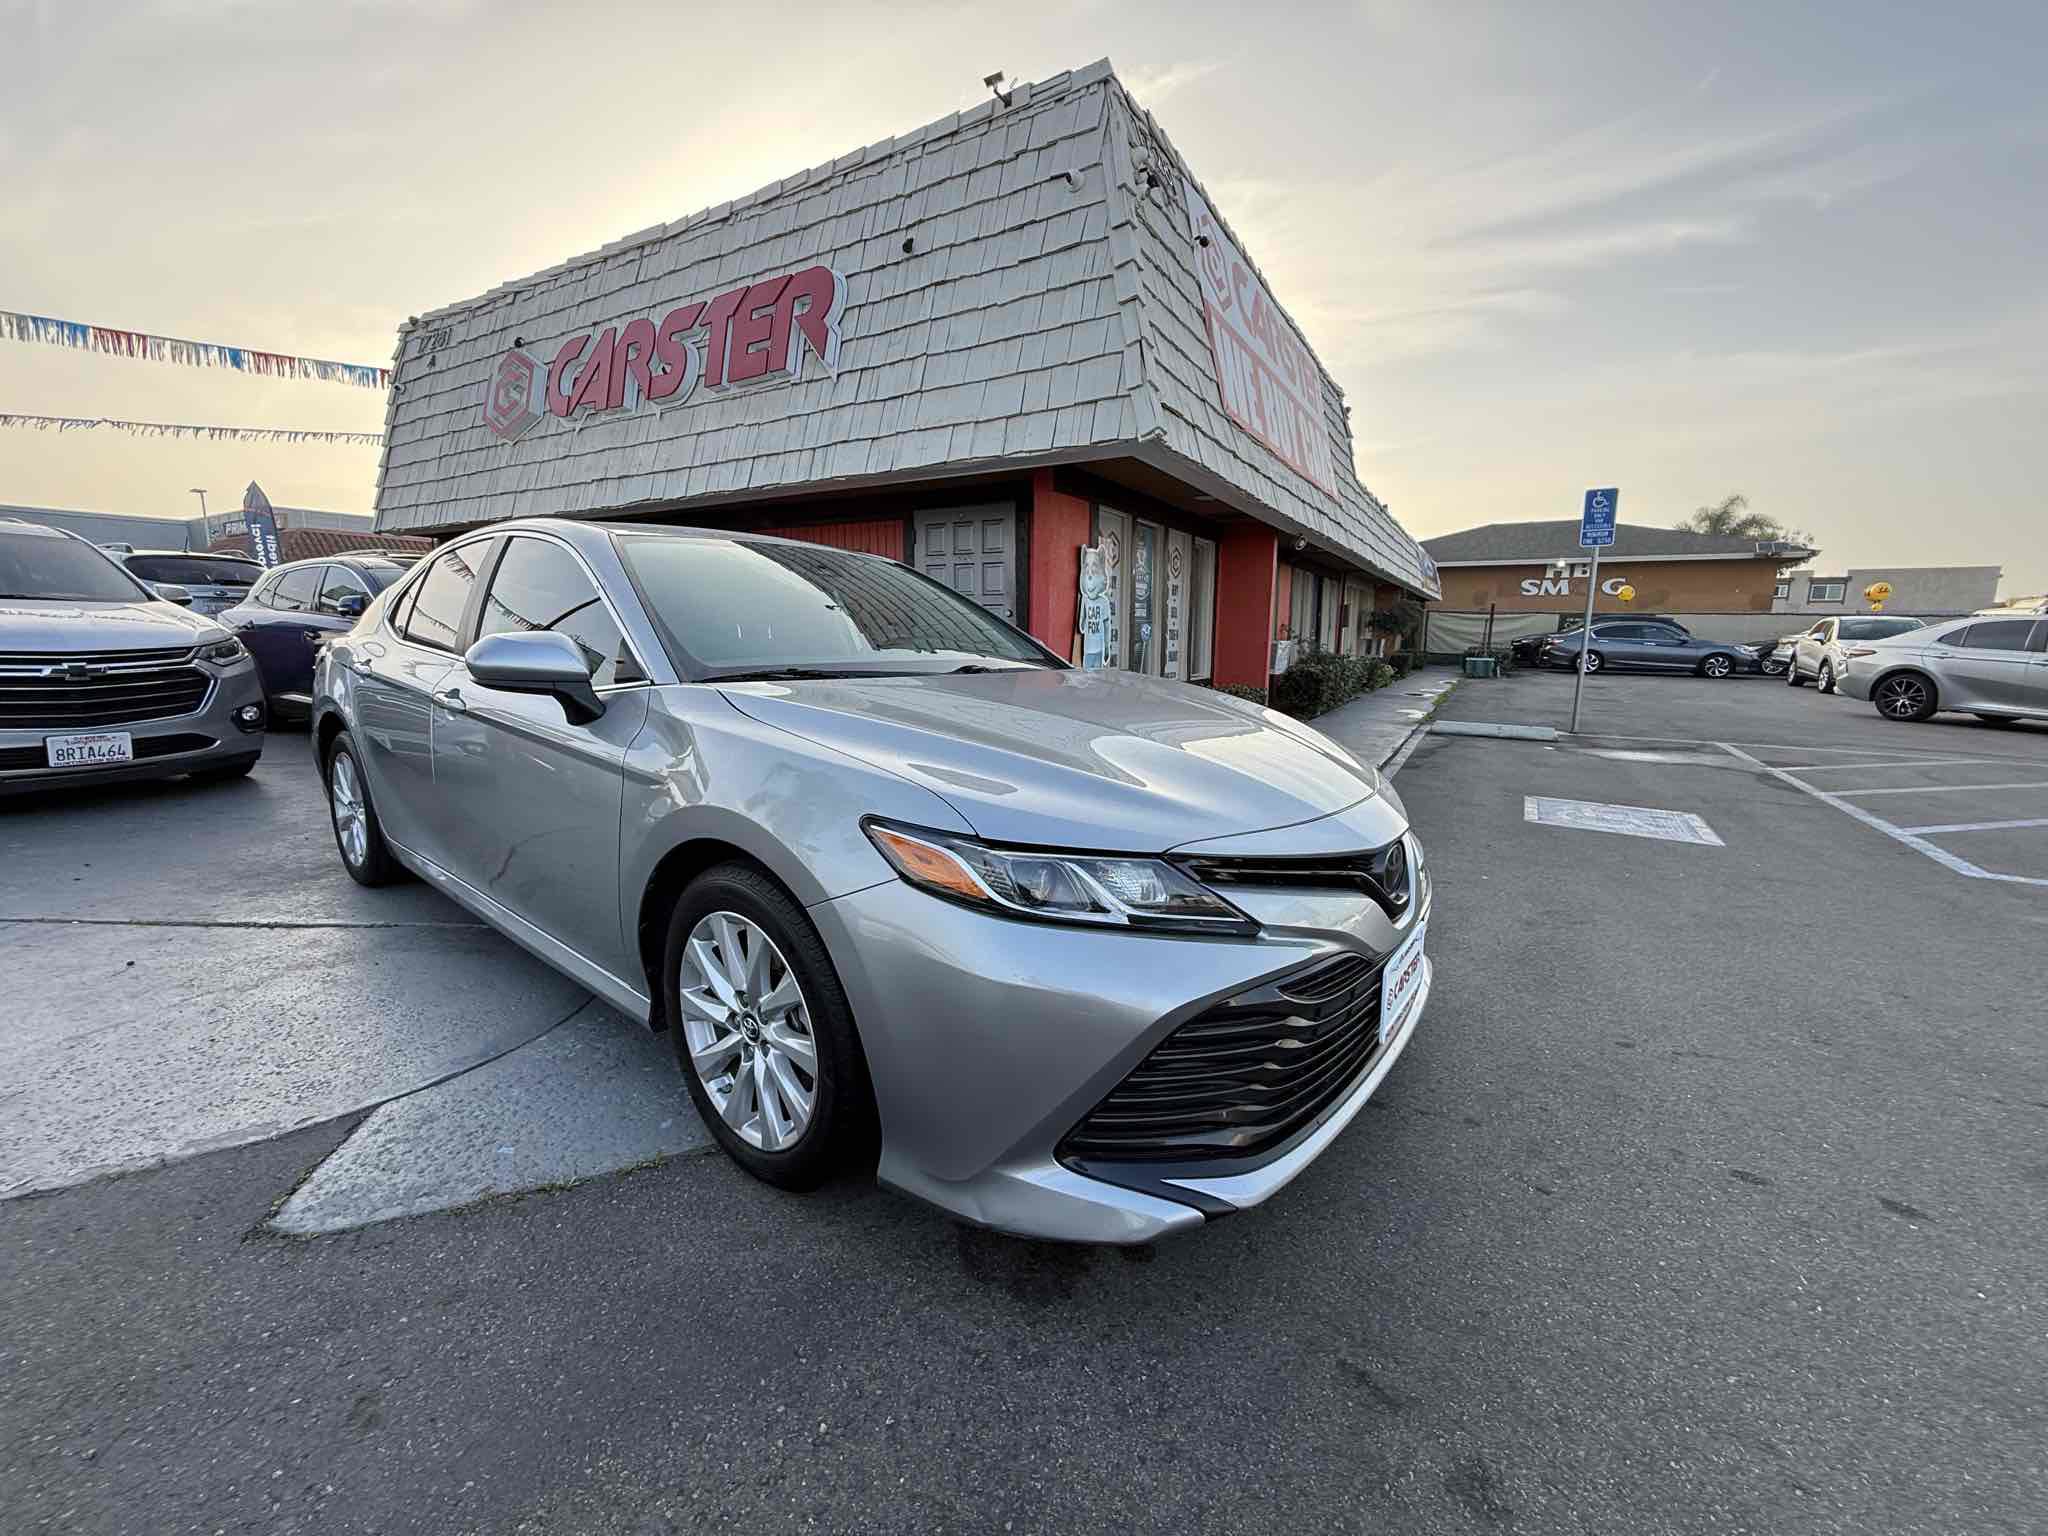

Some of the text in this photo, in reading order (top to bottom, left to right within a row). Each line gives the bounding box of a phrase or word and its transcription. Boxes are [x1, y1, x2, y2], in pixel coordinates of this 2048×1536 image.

[550, 266, 842, 419] CARSTER
[1087, 605, 1101, 619] CAR
[1087, 620, 1100, 634] FOX
[55, 743, 126, 762] 8RIA464
